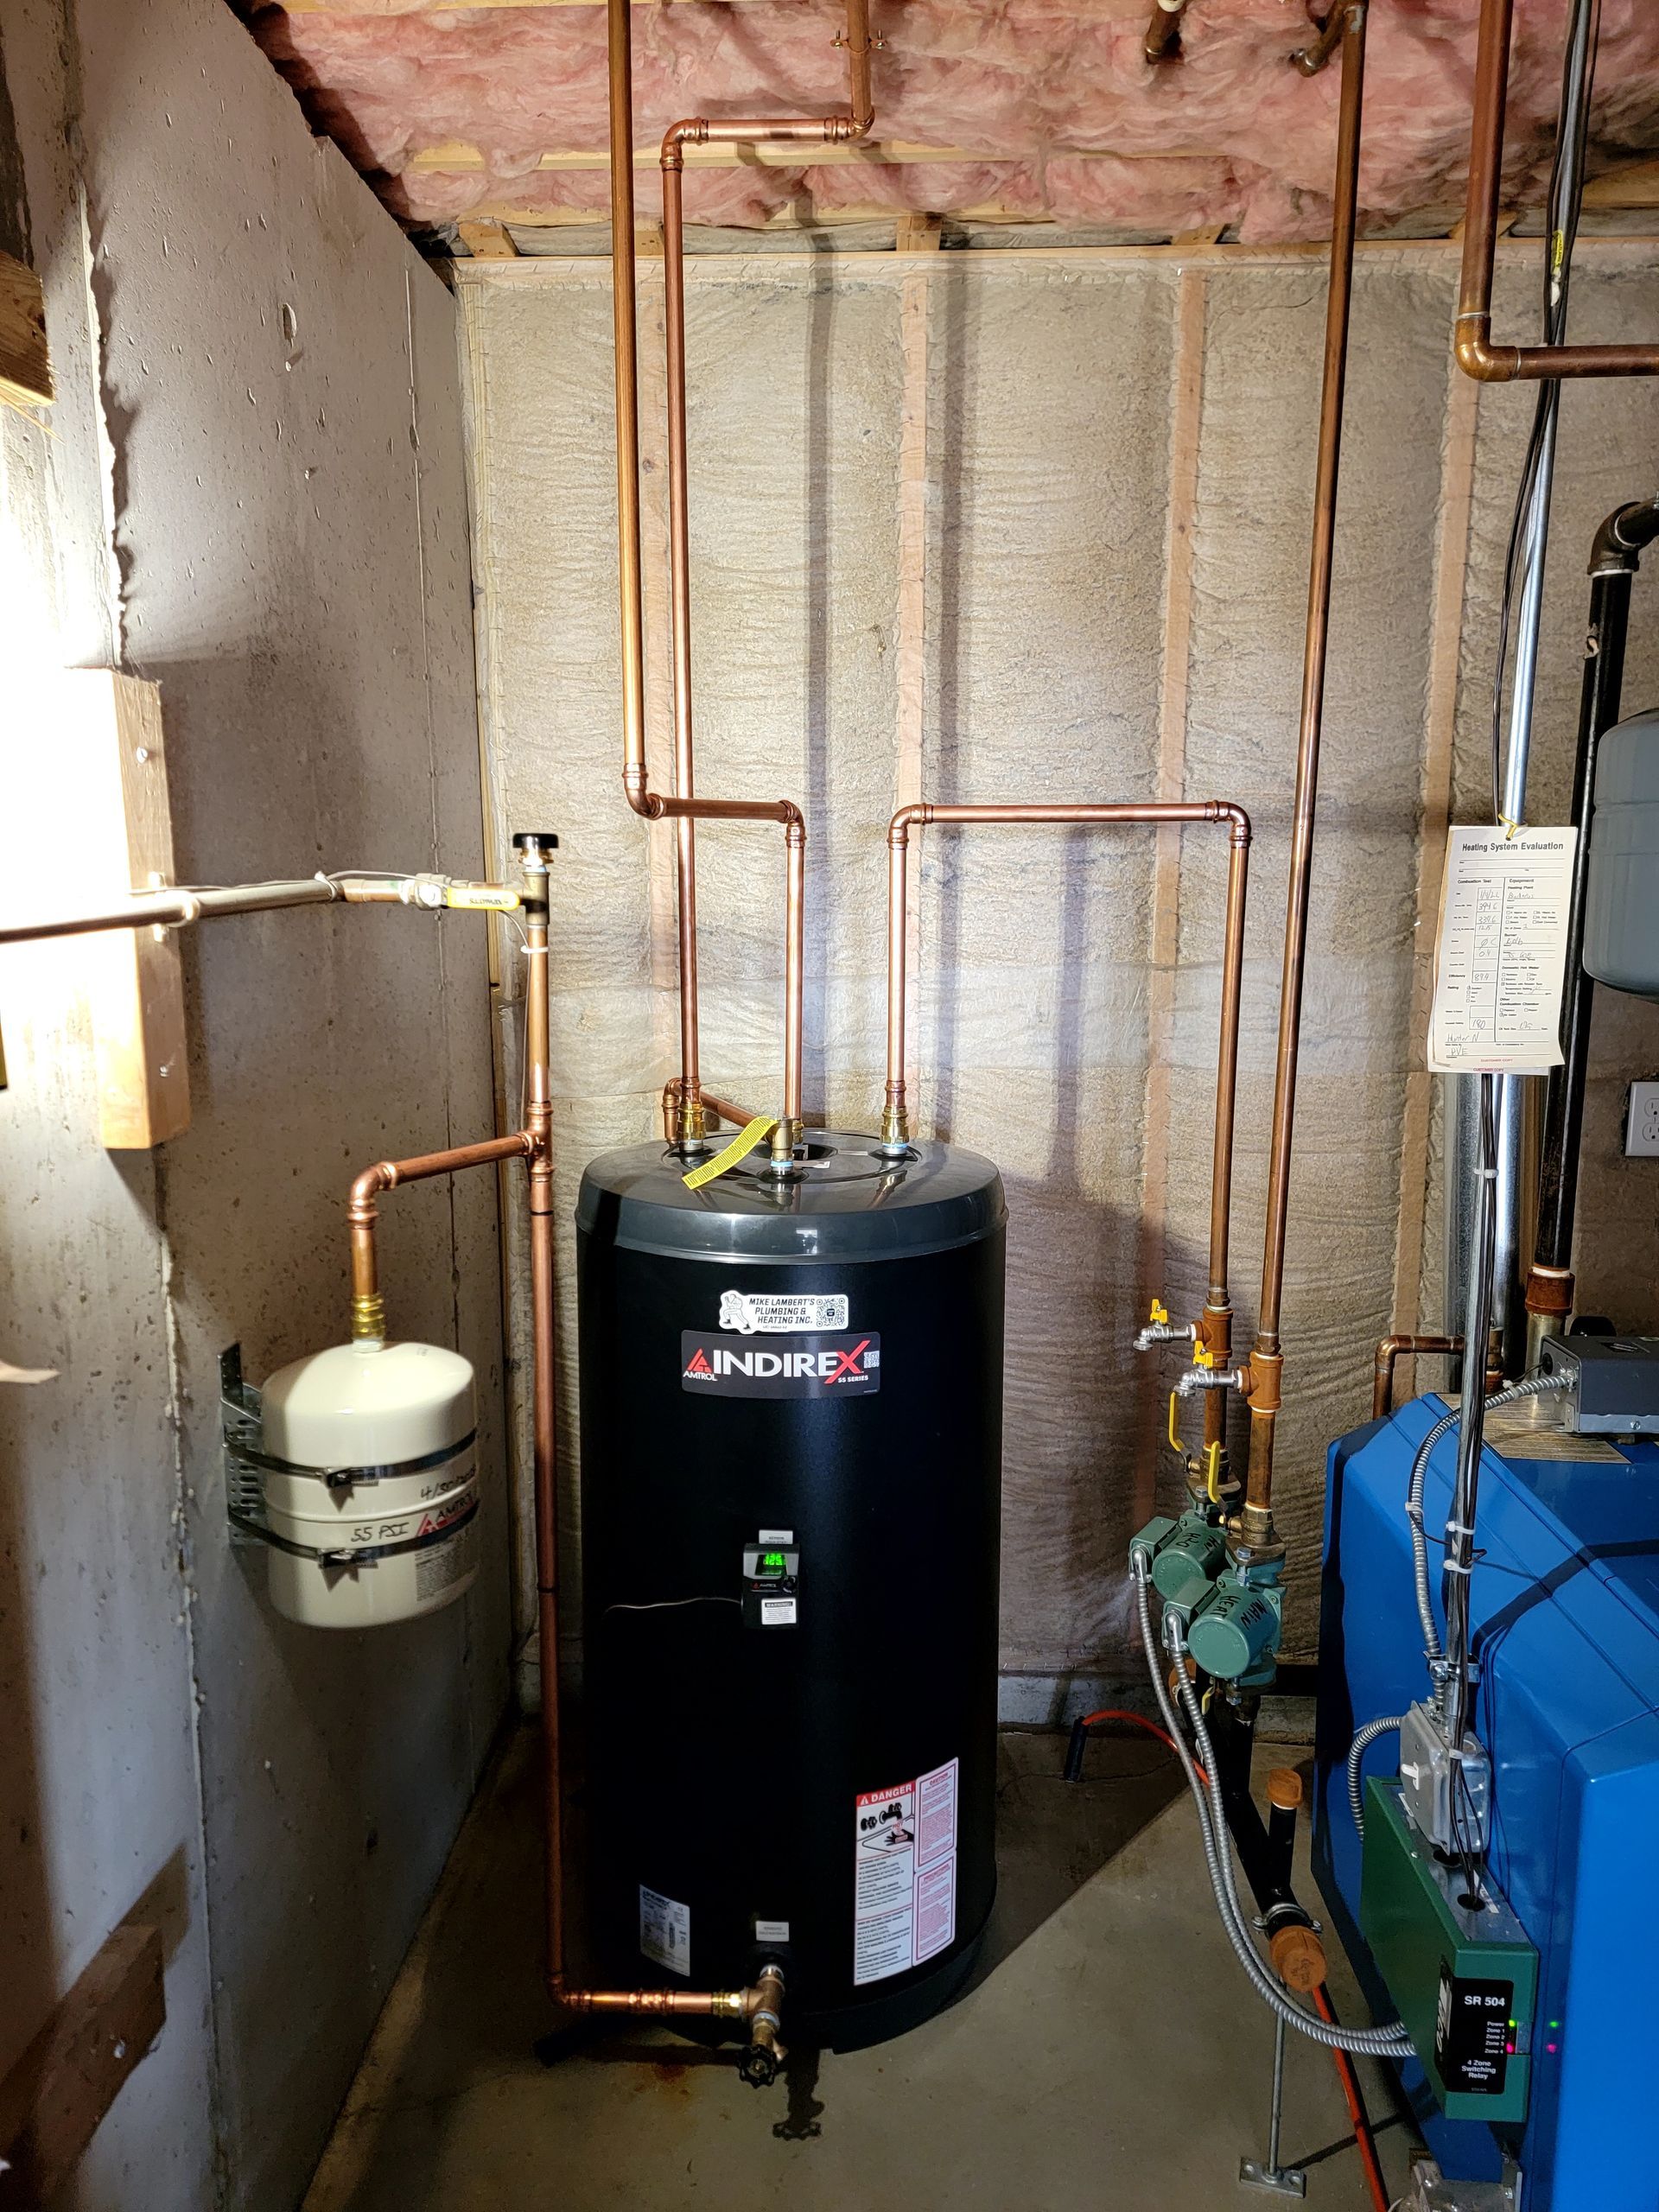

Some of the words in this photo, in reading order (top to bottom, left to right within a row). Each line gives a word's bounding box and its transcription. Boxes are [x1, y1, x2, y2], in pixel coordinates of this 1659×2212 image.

[1462, 843, 1488, 852] Heating
[1491, 842, 1518, 852] System
[1521, 842, 1564, 850] Evaluation
[713, 1340, 871, 1384] INDIREX
[683, 1371, 718, 1382] AMTROL
[351, 1527, 373, 1542] 55
[378, 1522, 410, 1540] PSI
[1210, 1595, 1242, 1618] HEAT
[871, 1783, 912, 1802] DANGER
[1464, 1995, 1482, 2006] SR
[1484, 1996, 1505, 2006] 504
